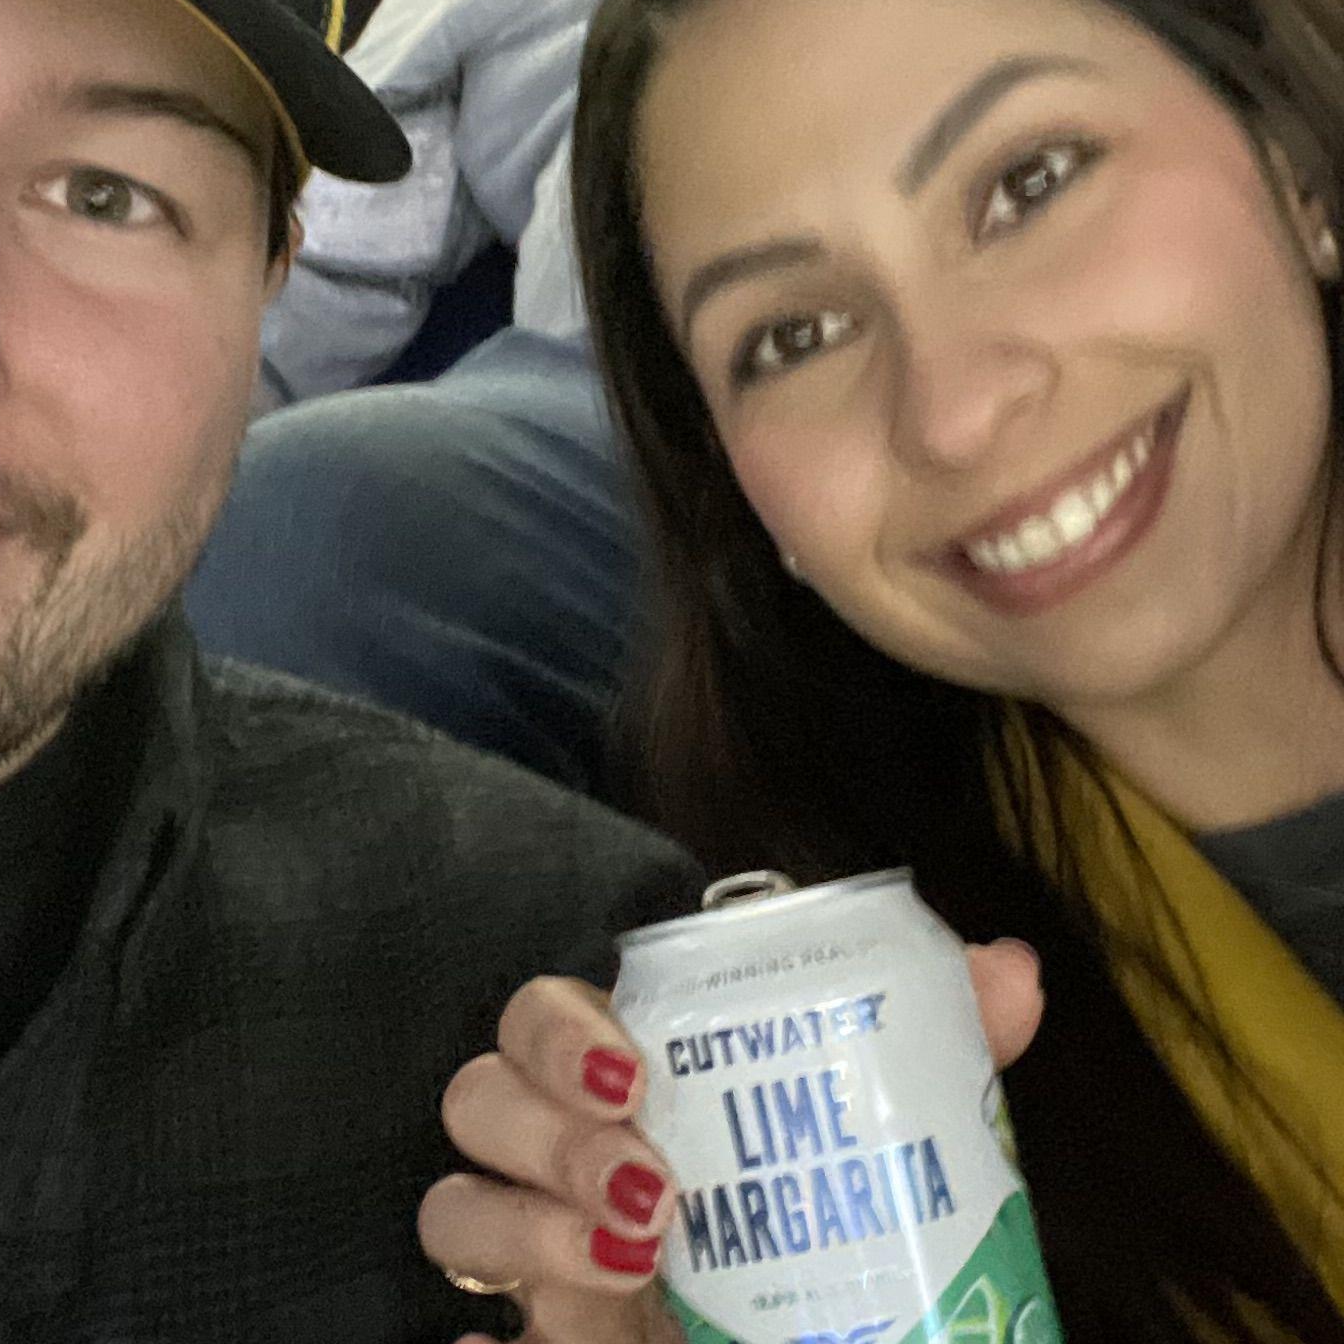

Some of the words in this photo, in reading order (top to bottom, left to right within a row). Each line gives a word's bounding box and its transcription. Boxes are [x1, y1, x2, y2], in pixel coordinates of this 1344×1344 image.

[665, 992, 887, 1078] CUTWATER
[722, 1066, 857, 1172] LIME
[676, 1135, 956, 1274] MARGARITA
